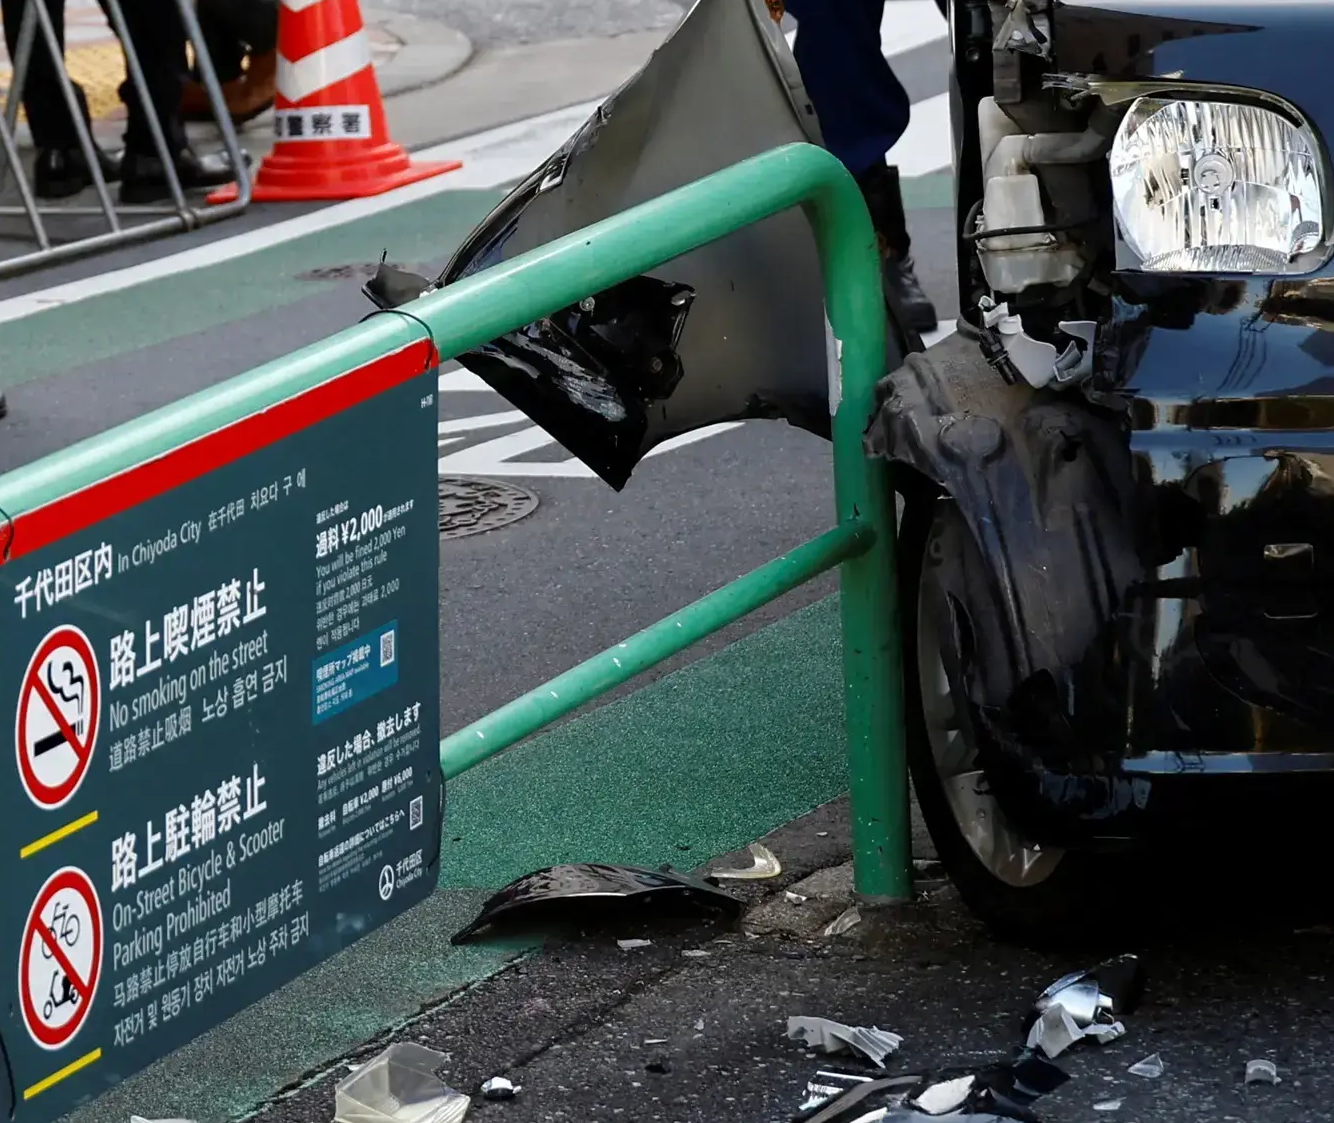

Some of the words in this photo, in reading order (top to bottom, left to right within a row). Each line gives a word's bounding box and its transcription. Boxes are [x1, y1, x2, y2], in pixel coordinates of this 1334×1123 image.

[208, 498, 245, 532] 在千代田
[250, 482, 279, 511] 치요다
[282, 475, 292, 496] 구
[297, 468, 306, 488] 에
[118, 553, 129, 573] In
[132, 532, 177, 567] Chiyoda
[180, 520, 201, 544] City
[316, 524, 339, 559] 過料
[341, 505, 383, 544] ¥2,000
[316, 565, 330, 578] You
[331, 552, 344, 572] will
[345, 550, 353, 564] be
[355, 542, 373, 560] fined
[373, 532, 392, 555] 2,000
[392, 525, 406, 541] Yen
[14, 542, 112, 618] 千代田区内
[322, 577, 336, 596] you
[337, 564, 360, 586] violate
[360, 555, 373, 573] this
[374, 550, 387, 567] rule
[380, 578, 400, 598] 2,000
[109, 567, 267, 691] 路上喫煙禁止
[110, 701, 128, 732] No
[132, 672, 187, 721] smoking
[190, 663, 206, 691] on
[209, 649, 229, 680] the
[232, 629, 268, 670] street
[202, 686, 229, 723] 노상
[232, 671, 258, 709] 흡연
[262, 654, 288, 693] 금지
[109, 705, 192, 772] 道路禁止吸烟
[317, 702, 421, 776] 違反した場合、撤去します
[342, 797, 359, 817] 自転車
[360, 785, 379, 805] ¥2,000
[381, 778, 393, 794] 原付
[111, 763, 267, 893] 路上駐輪禁止
[112, 875, 174, 932] On-Street
[178, 849, 222, 895] Bicycle
[226, 840, 236, 869] &
[239, 818, 285, 862] Scooter
[395, 849, 423, 877] 千代田区
[396, 872, 413, 889] Chiyoda
[414, 869, 423, 882] City
[113, 923, 163, 972] Parking
[167, 877, 232, 942] Prohibited
[113, 1010, 145, 1048] 자전거
[147, 999, 157, 1031] 및
[161, 984, 191, 1023] 원동기
[193, 967, 214, 1004] 장치
[216, 948, 245, 987] 자전거
[247, 936, 266, 969] 노상
[268, 923, 288, 958] 주차
[290, 910, 310, 946] 금지
